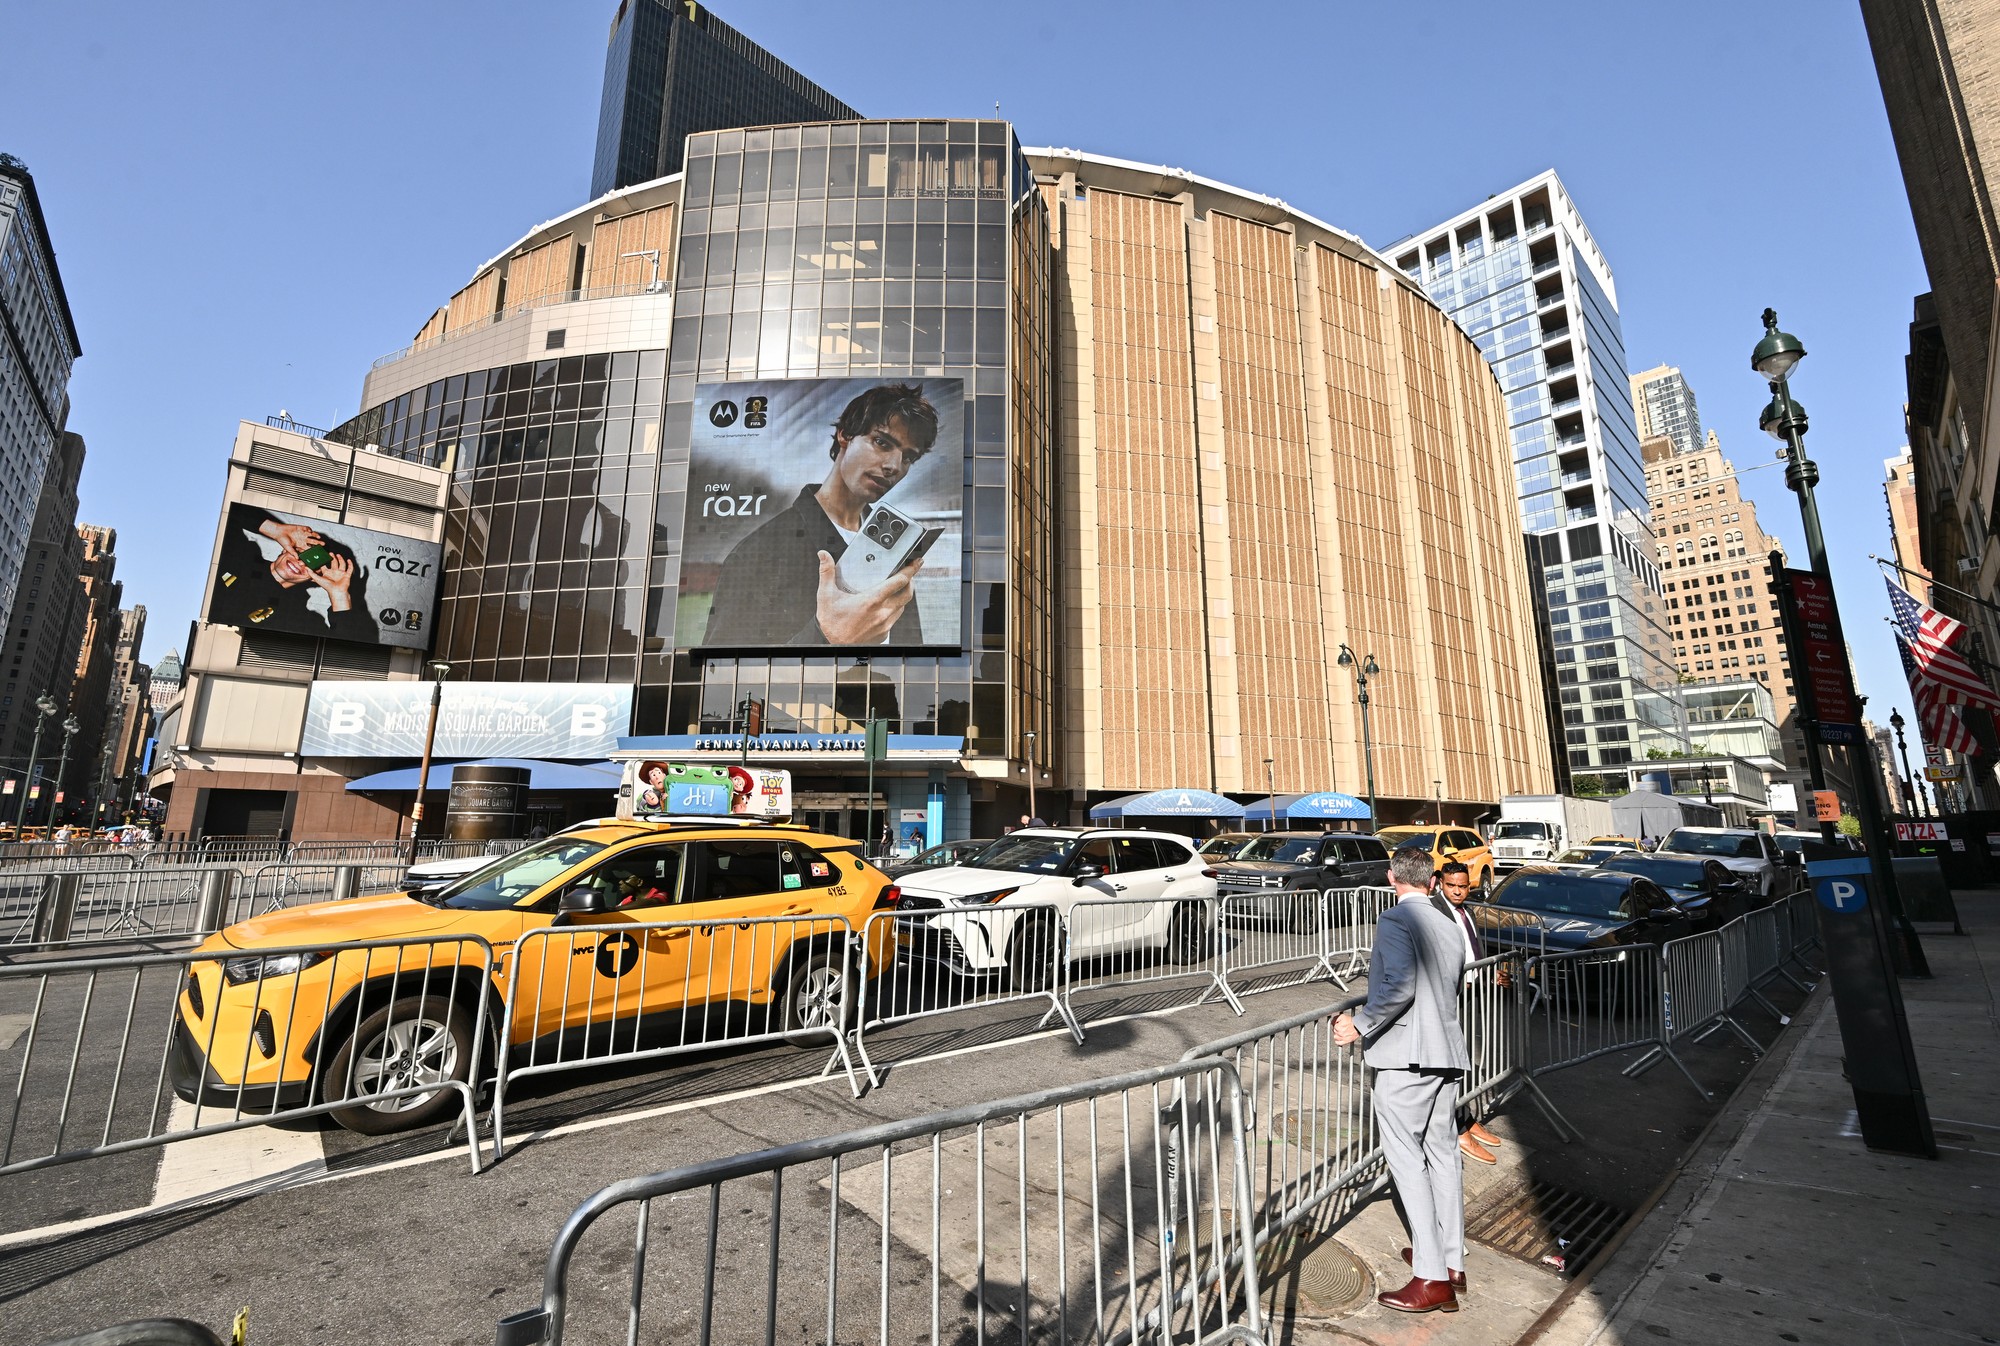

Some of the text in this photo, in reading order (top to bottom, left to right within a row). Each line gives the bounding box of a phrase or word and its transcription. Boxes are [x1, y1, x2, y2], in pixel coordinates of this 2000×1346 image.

[704, 483, 730, 492] new
[702, 494, 767, 517] razr
[378, 545, 401, 554] new
[375, 556, 432, 578] razr
[1806, 593, 1830, 602] Authorized
[1808, 622, 1828, 630] Amtrak
[1811, 632, 1828, 640] Police
[328, 702, 366, 734] B
[445, 712, 493, 732] SQUARE
[570, 704, 608, 736] B
[695, 739, 866, 749] PENNSYLVANIA STATIO
[760, 776, 784, 788] TOY
[683, 787, 715, 807] Hi!
[768, 794, 777, 807] 5
[1177, 792, 1192, 806] A
[1311, 798, 1353, 808] 4 PENN
[1896, 824, 1938, 840] PIZZA
[1832, 882, 1855, 907] P
[573, 946, 595, 956] NYC
